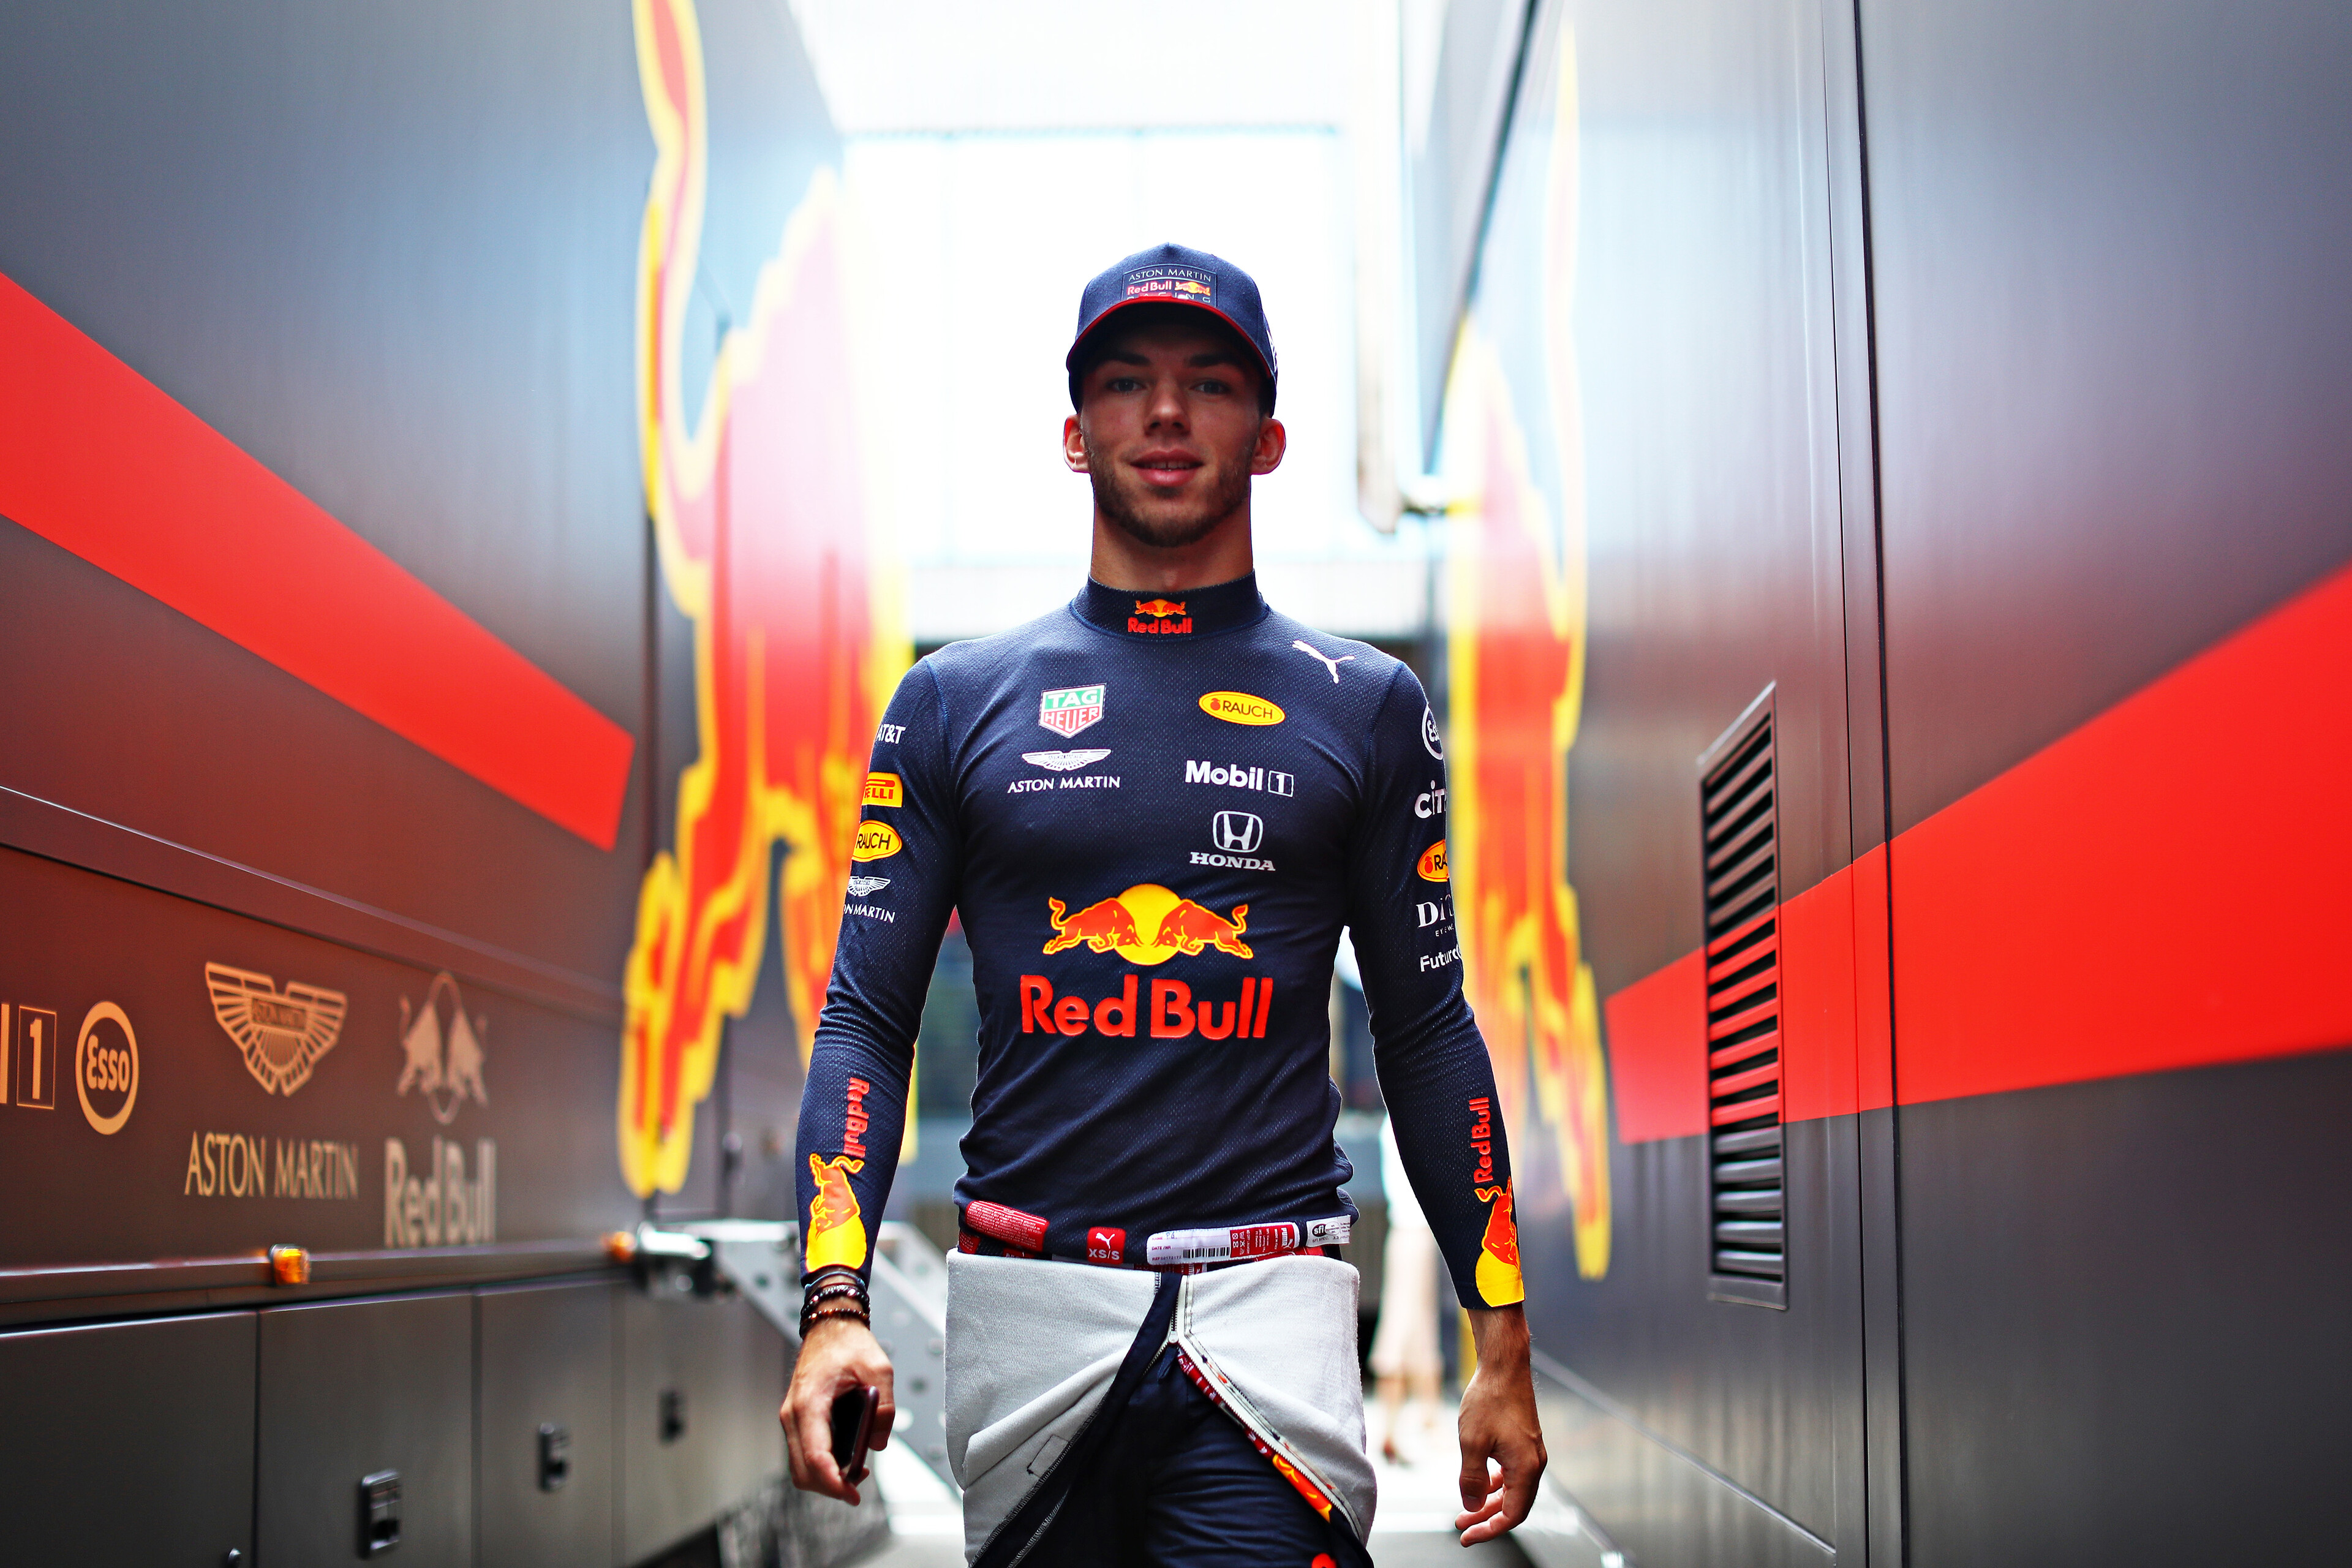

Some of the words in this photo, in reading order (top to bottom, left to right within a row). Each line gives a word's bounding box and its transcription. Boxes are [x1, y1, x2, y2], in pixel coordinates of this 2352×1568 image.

[1128, 269, 1163, 282] ASTON
[1168, 269, 1211, 282] MARTIN
[1127, 282, 1148, 295] Red
[1150, 281, 1172, 291] Bull
[1128, 617, 1159, 634] Red
[1161, 617, 1192, 634] Bull
[1048, 690, 1098, 708] TAG
[1223, 700, 1273, 719] RAUCH
[1045, 707, 1098, 733] HEUER
[876, 724, 906, 744] AT&T
[1007, 778, 1055, 794] ASTON
[1060, 776, 1121, 789] MARTIN
[1185, 760, 1264, 791] Mobil
[856, 832, 891, 850] RAUCH
[1189, 851, 1276, 871] HONDA
[1434, 851, 1448, 871] RA
[854, 903, 895, 924] MARTIN
[1020, 974, 1139, 1037] Red
[1150, 977, 1273, 1041] Bull
[29, 1018, 42, 1099] 1
[86, 1034, 130, 1092] Esso
[847, 1077, 870, 1120] Red
[1469, 1097, 1491, 1139] Bull
[843, 1116, 868, 1158] Bull
[184, 1131, 266, 1197] ASTON
[274, 1137, 360, 1199] MARTIN
[1471, 1140, 1493, 1183] Red
[383, 1134, 445, 1249] Red
[445, 1136, 497, 1247] Bull
[1314, 1225, 1324, 1234] sfi
[1088, 1248, 1120, 1260] XS/S
